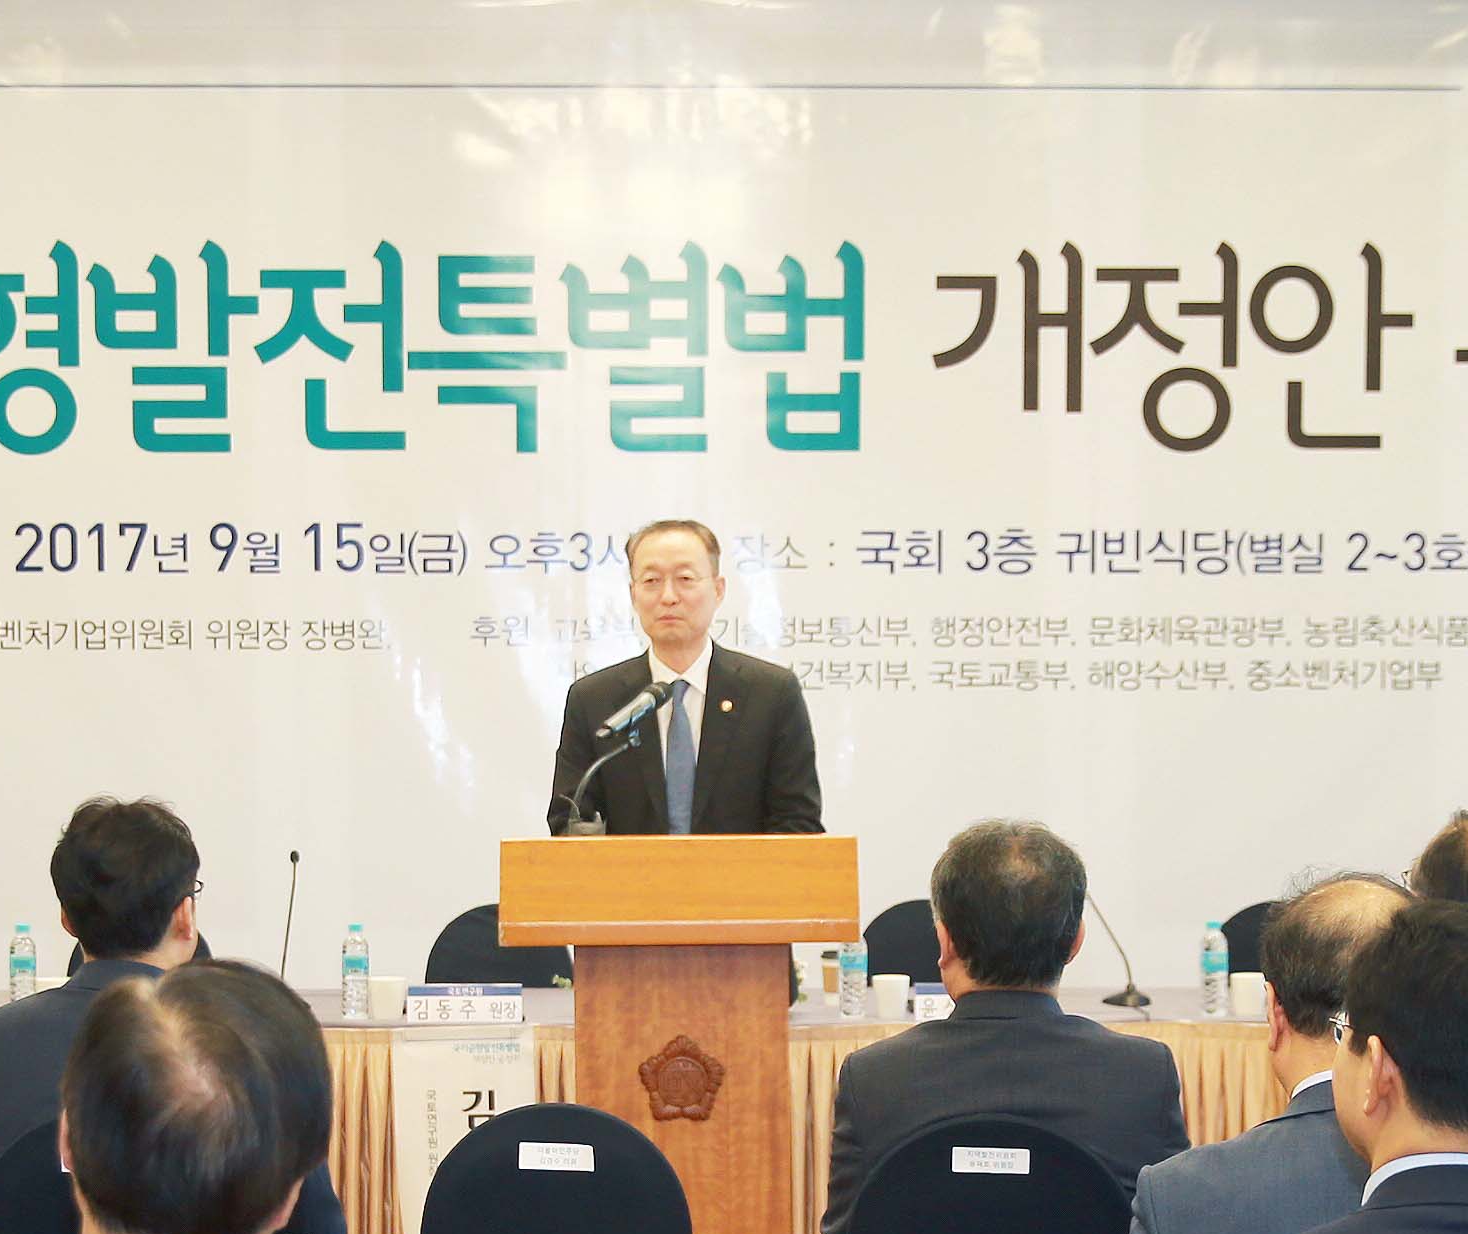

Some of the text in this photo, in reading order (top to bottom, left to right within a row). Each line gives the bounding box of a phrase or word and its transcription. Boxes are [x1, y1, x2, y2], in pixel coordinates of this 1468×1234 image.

[932, 240, 1414, 453] 개정안
[14, 521, 189, 574] 2017년
[209, 521, 282, 575] 9월
[303, 521, 468, 577] 15일(금)
[734, 534, 808, 576] 장소
[855, 528, 944, 577] 국회
[964, 528, 1039, 577] 3층
[1055, 528, 1325, 577] 귀빈식당(별실
[205, 618, 291, 651] 위원장
[470, 615, 530, 648] 후원
[931, 615, 1076, 648] 행정안전부,
[1087, 615, 1292, 648] 문화체육관광부,
[791, 659, 1443, 692] 건복지부, 국토교통부, 해양수산부, 중소벤처기업부
[489, 1000, 517, 1020] 원장
